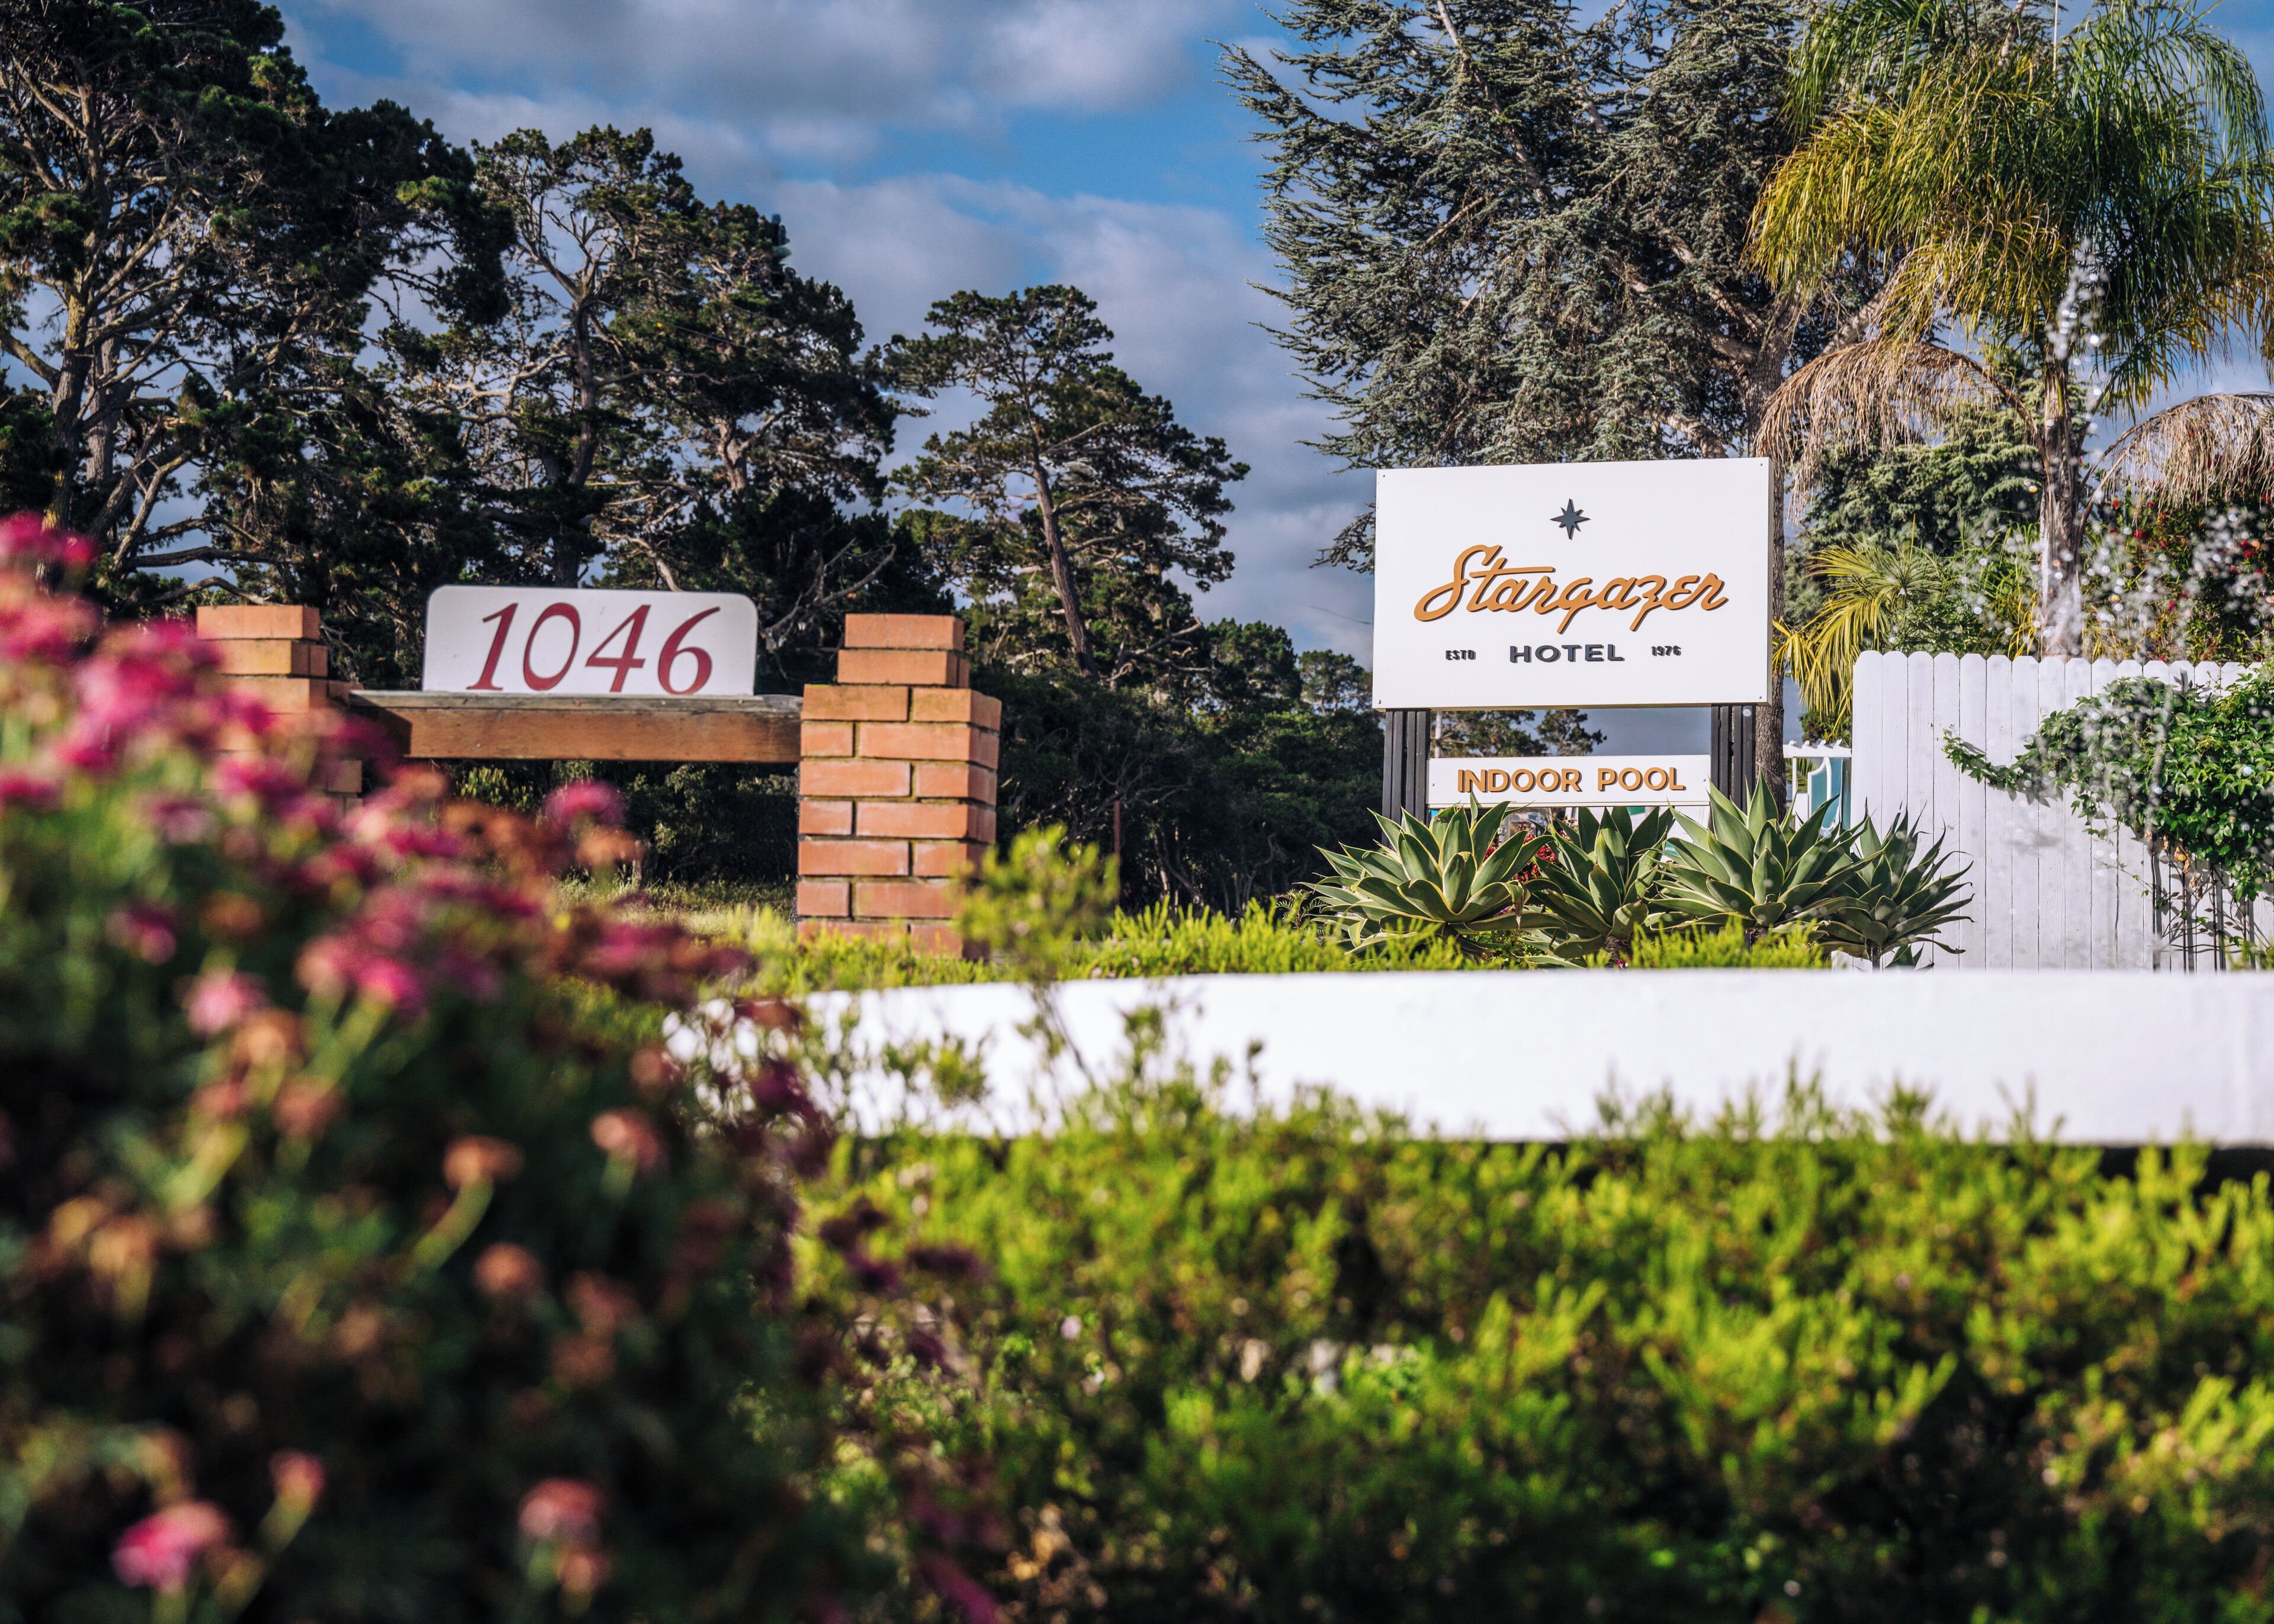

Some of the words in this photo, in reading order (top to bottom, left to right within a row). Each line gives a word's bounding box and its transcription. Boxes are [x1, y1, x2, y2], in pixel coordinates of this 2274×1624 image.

[1414, 545, 1729, 634] Stargazer
[467, 602, 721, 695] 1046
[1446, 649, 1476, 661] ESTD
[1510, 644, 1624, 663] HOTEL
[1651, 645, 1682, 657] 1976
[1457, 768, 1582, 793] INDOOR
[1597, 767, 1687, 792] POOL
